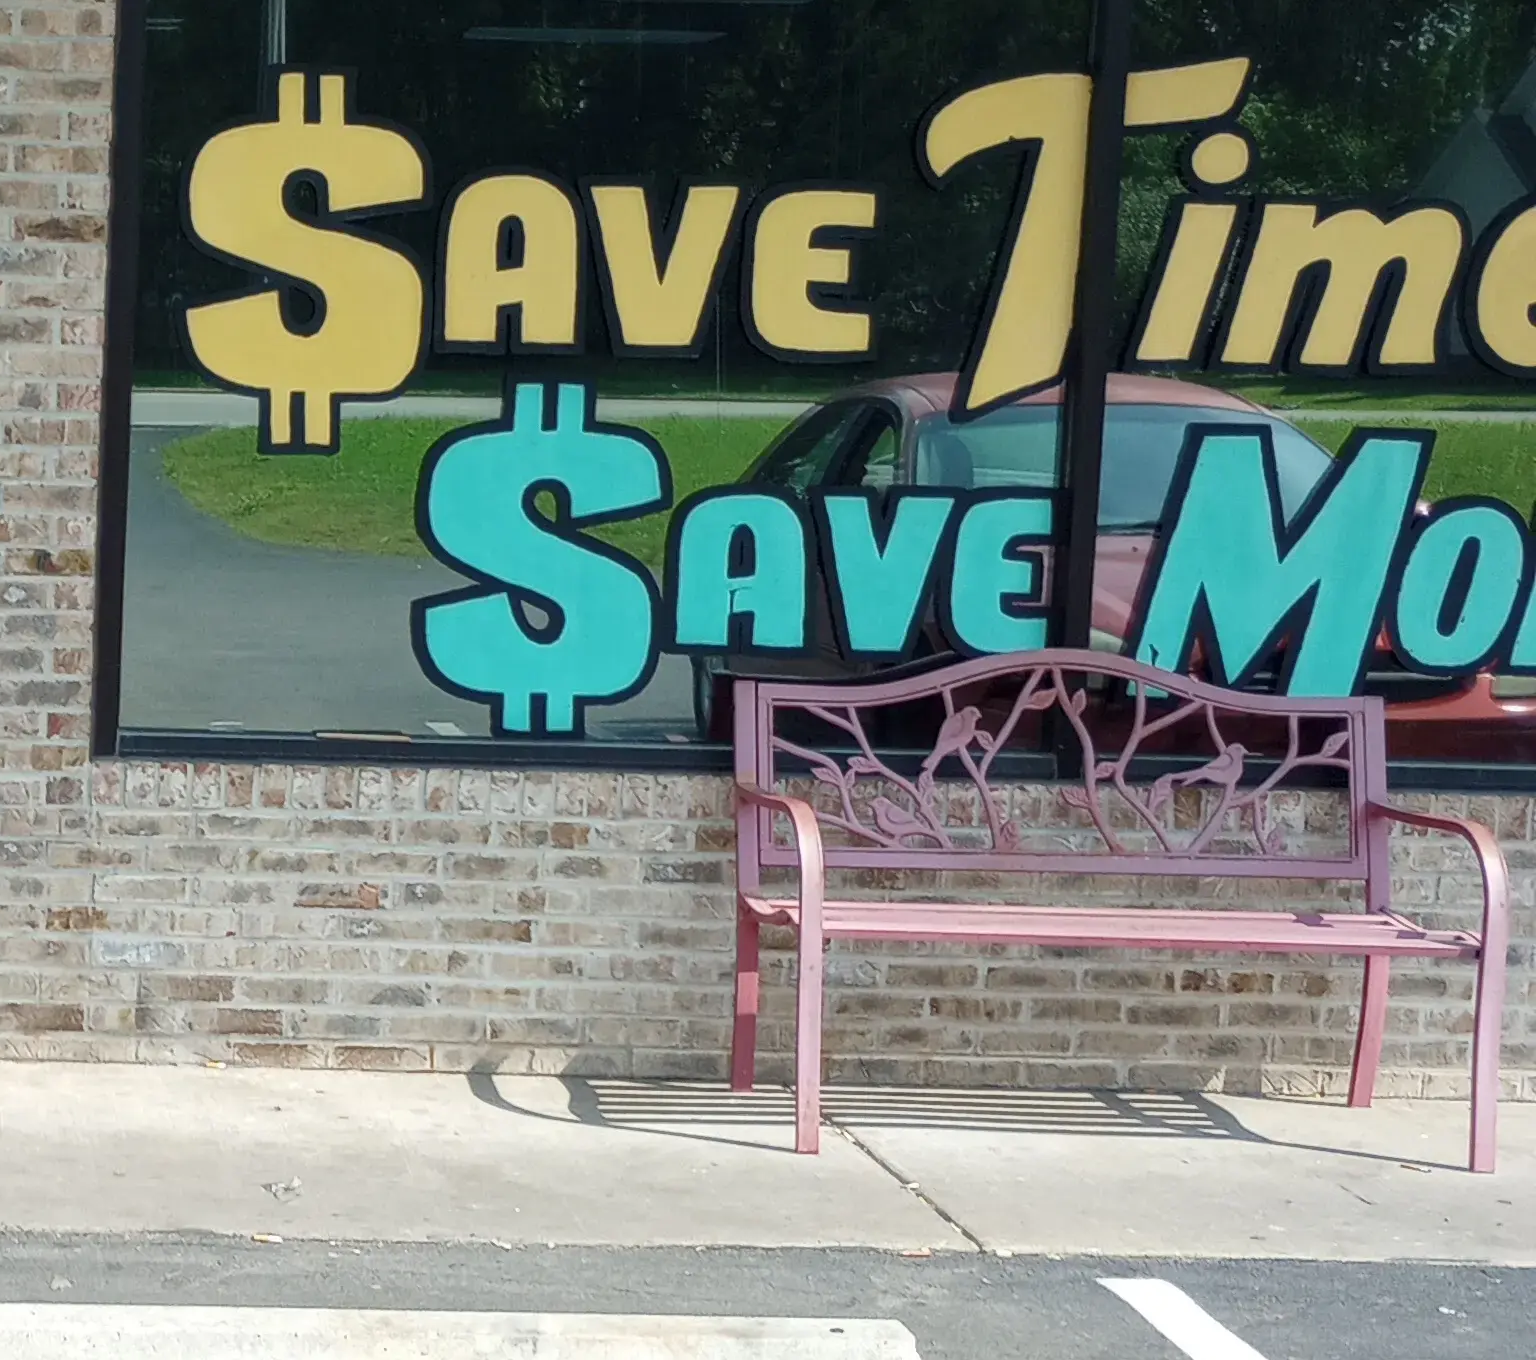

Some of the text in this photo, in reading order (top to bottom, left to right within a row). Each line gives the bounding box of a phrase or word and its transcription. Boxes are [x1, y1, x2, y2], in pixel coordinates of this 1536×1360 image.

[185, 71, 877, 446] $AVE
[425, 382, 1536, 732] $AVE Mo
